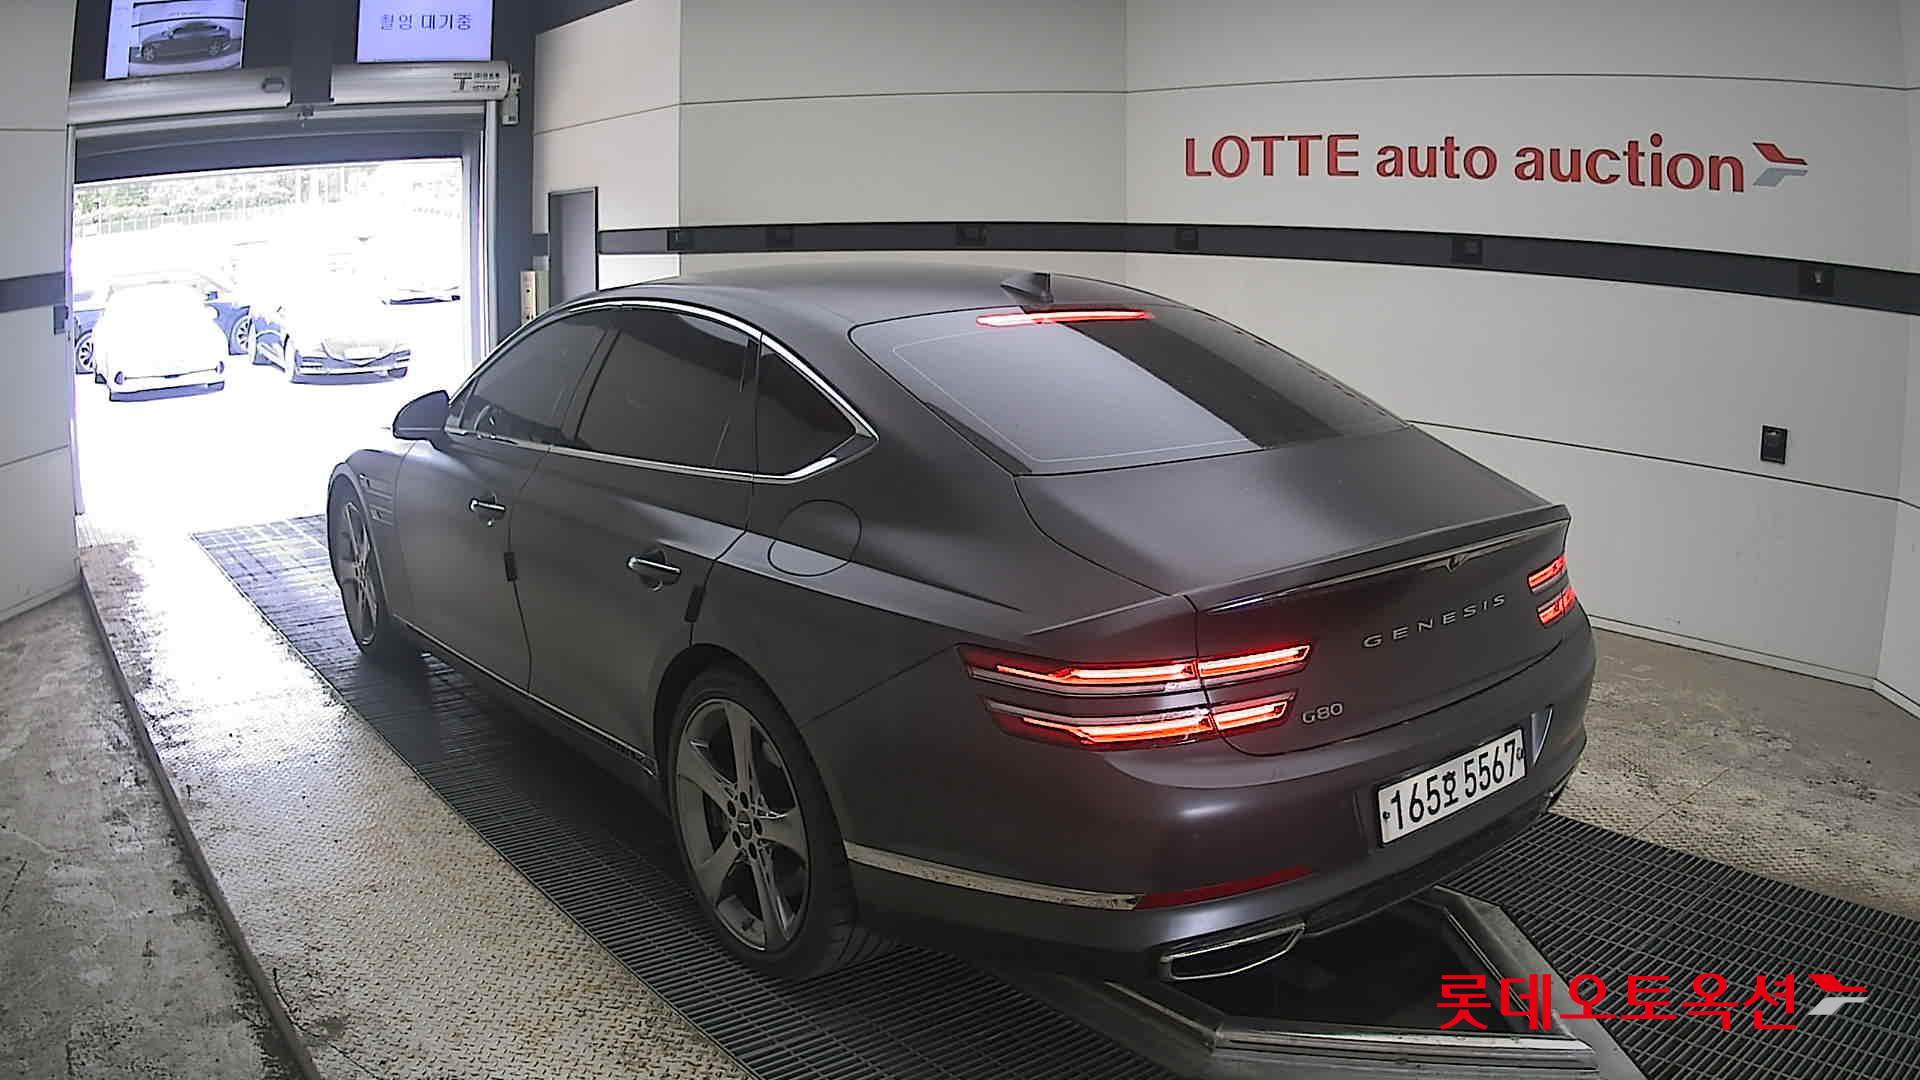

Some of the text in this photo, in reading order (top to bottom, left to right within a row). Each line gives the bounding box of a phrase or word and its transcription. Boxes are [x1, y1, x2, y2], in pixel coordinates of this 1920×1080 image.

[421, 13, 473, 31] 대기중
[1185, 133, 1744, 193] LOTTE auto auction
[1362, 593, 1506, 648] GENESIS
[1302, 702, 1344, 724] G80
[1390, 739, 1517, 830] 165호 5567
